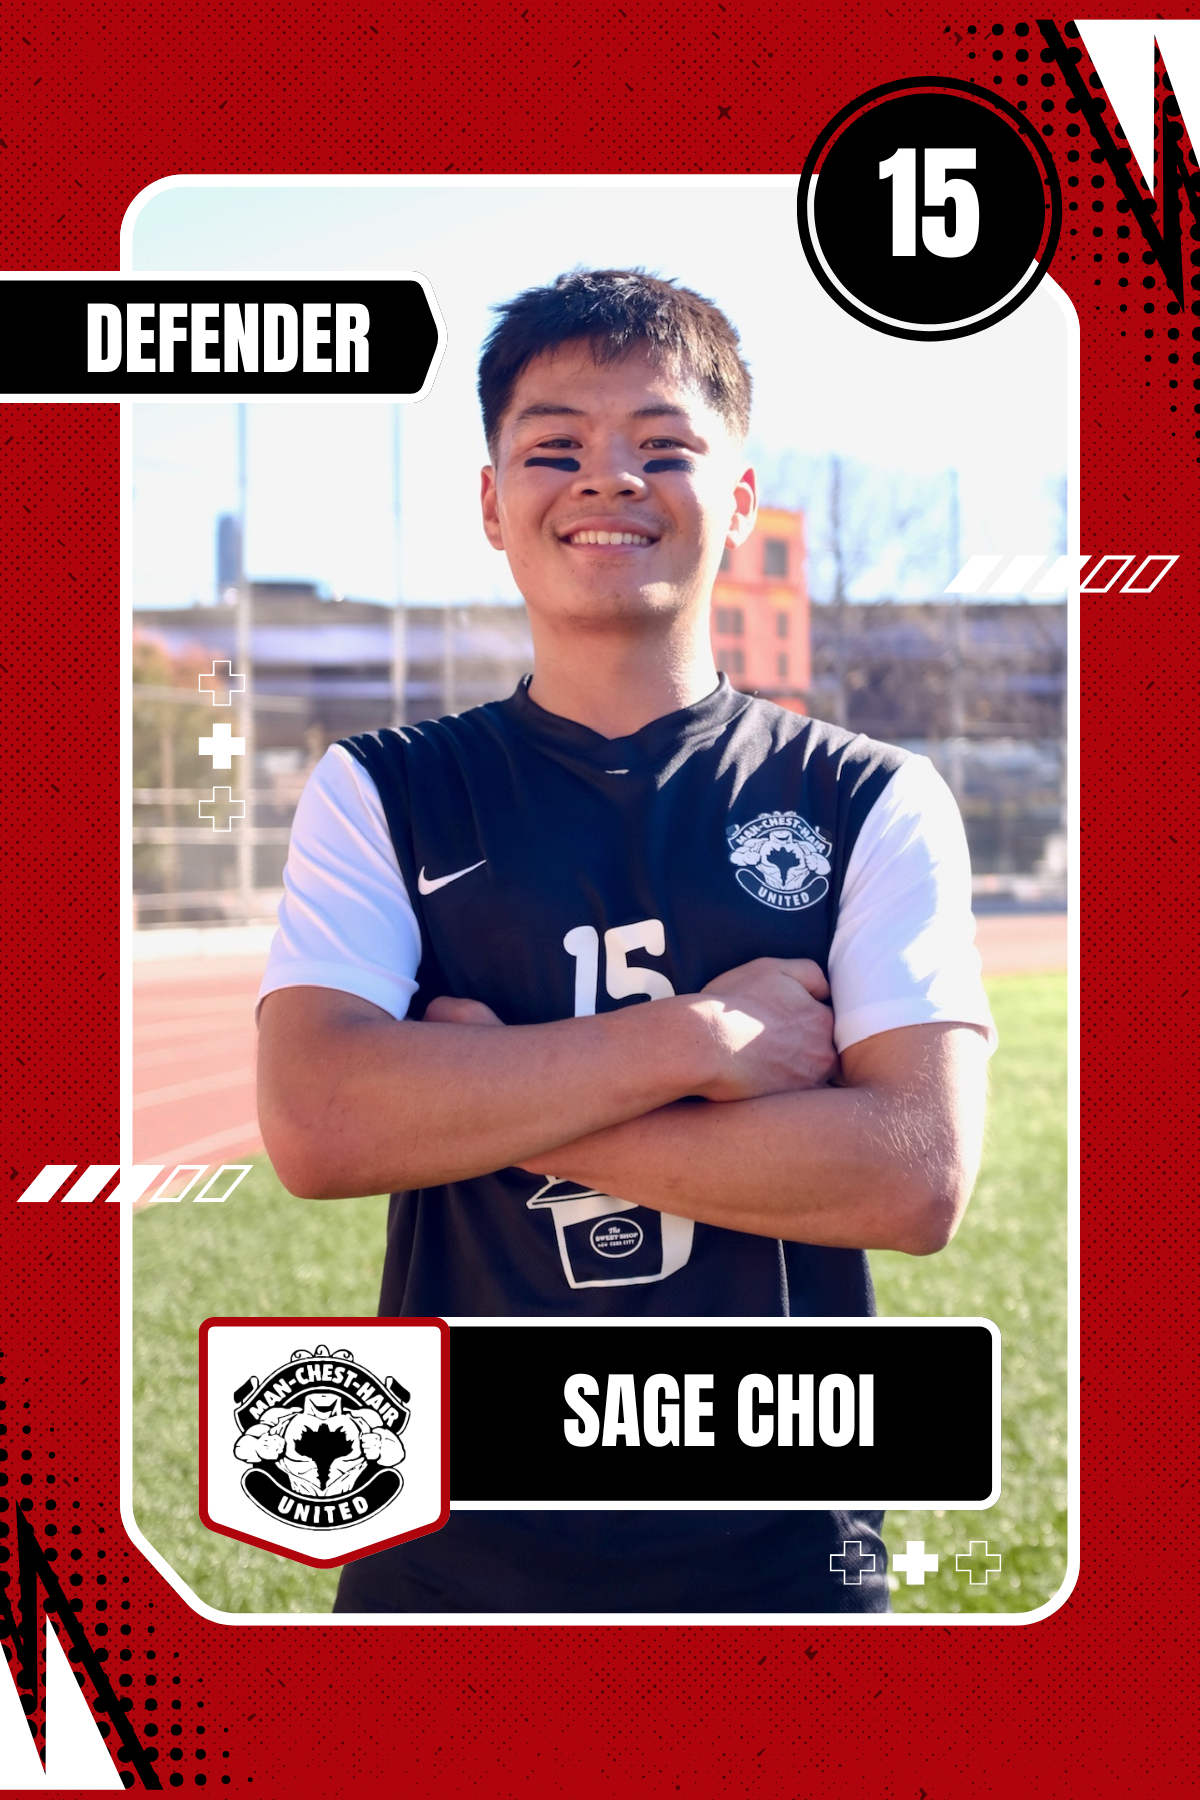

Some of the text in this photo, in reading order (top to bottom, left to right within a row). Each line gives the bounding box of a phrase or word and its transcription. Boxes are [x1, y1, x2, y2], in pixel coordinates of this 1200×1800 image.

[736, 817, 827, 854] MAN-CHEST-HAIR
[758, 886, 810, 907] UNITED
[595, 1232, 638, 1242] SWEET SHOP
[608, 1226, 621, 1234] The
